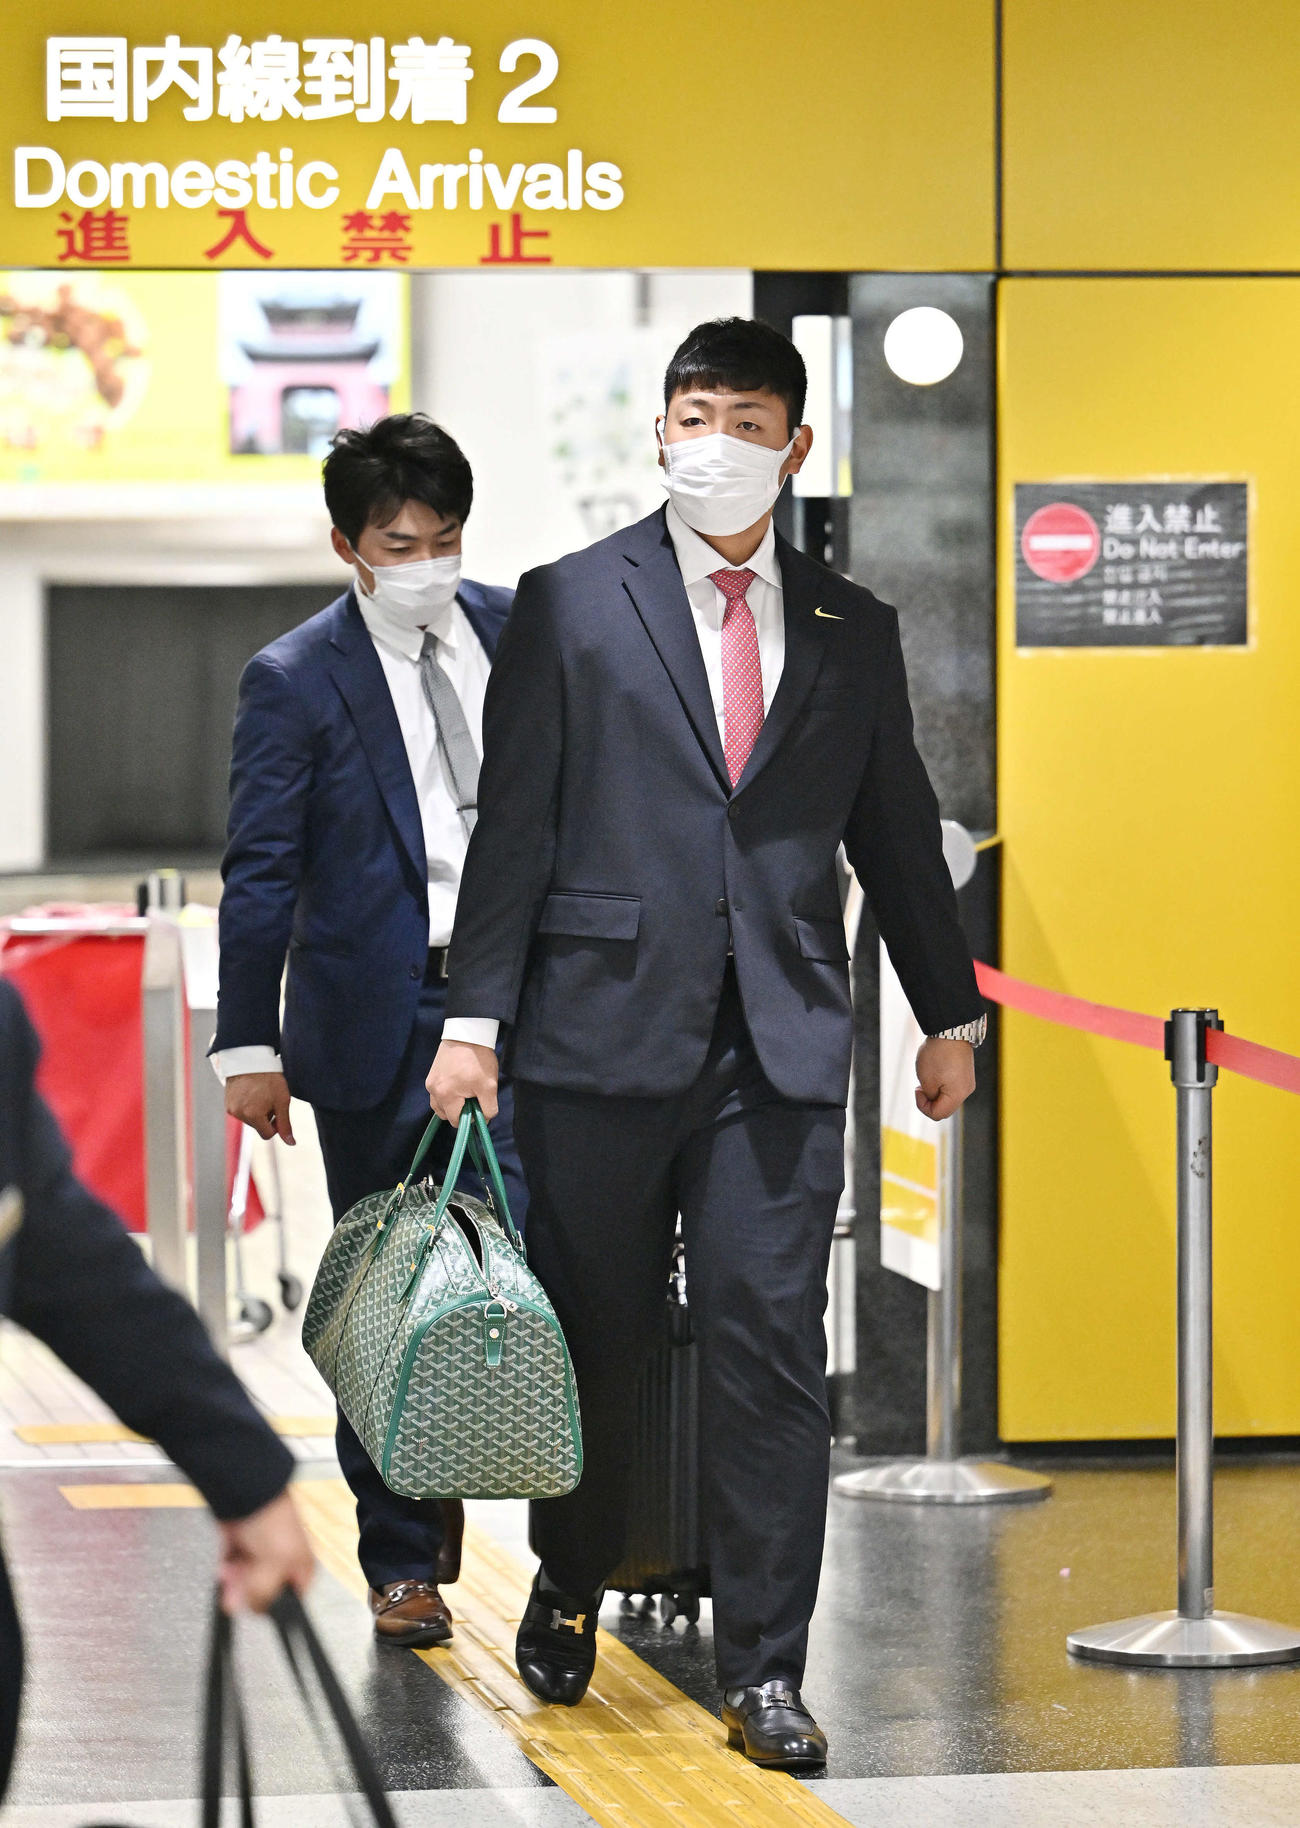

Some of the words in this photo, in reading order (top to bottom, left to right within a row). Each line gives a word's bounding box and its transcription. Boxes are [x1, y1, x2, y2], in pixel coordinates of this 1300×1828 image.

[45, 34, 474, 125] 国内線到着
[497, 38, 560, 124] 2
[13, 146, 340, 209] Domestic
[364, 147, 625, 211] Arrivals
[1104, 503, 1222, 534] 進入禁止
[1103, 537, 1135, 560] Do
[1139, 535, 1179, 560] Not
[1184, 535, 1245, 560] Enter
